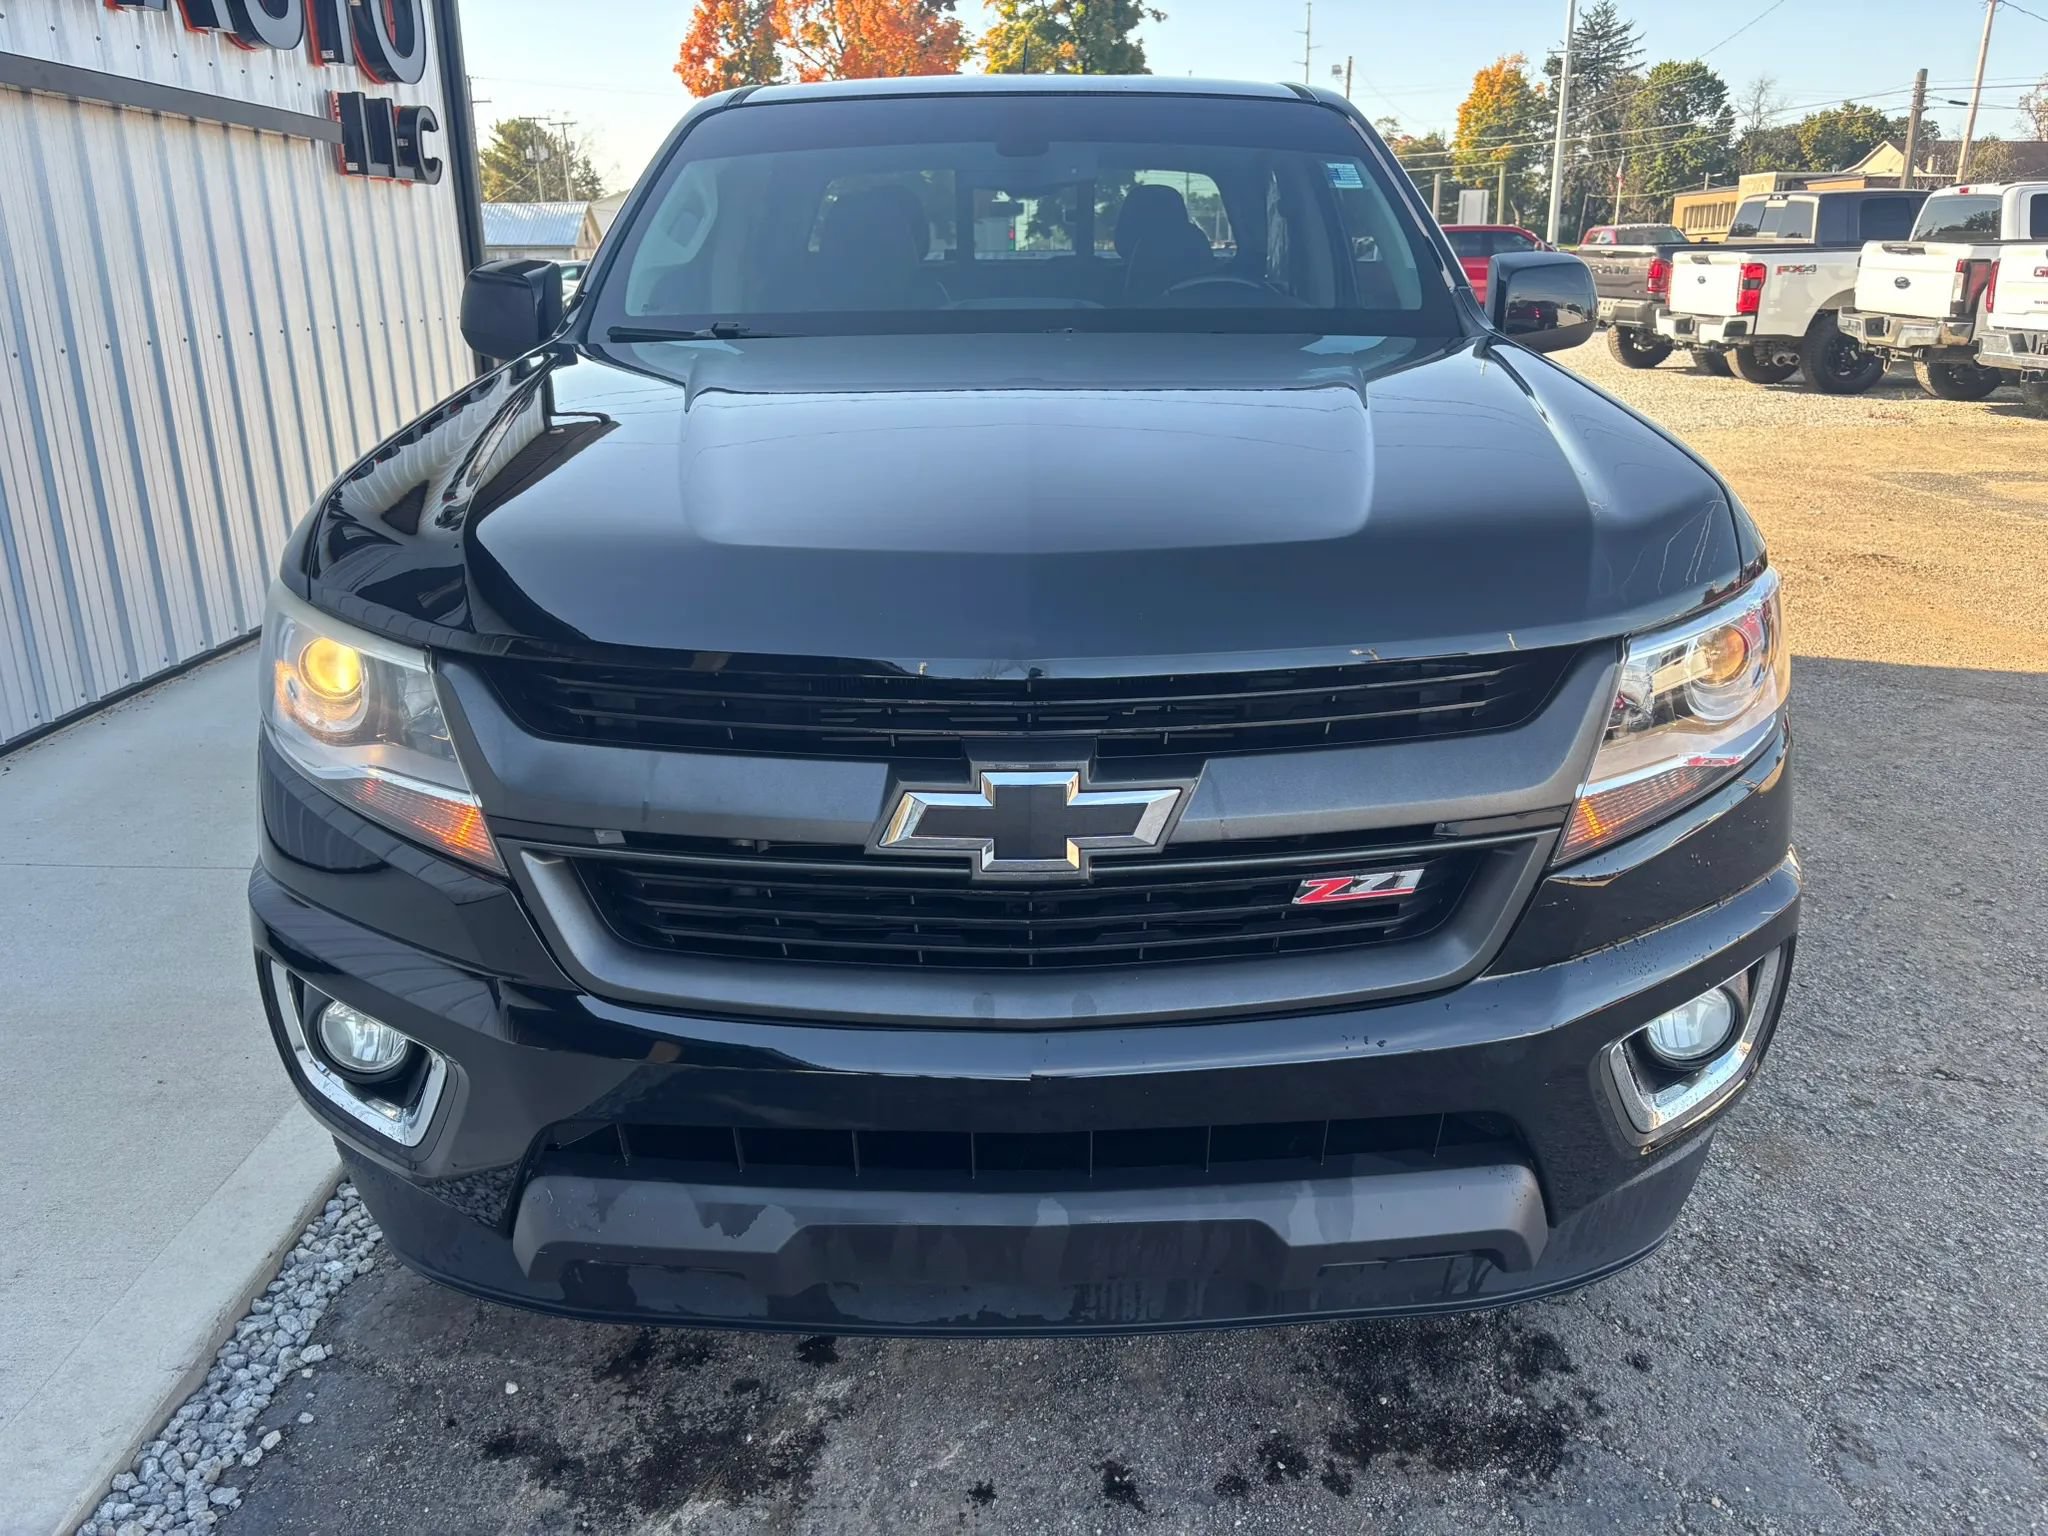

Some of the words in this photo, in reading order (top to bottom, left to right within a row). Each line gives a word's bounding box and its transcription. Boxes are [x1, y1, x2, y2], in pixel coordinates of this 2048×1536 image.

[335, 91, 443, 184] LLC
[1589, 264, 1630, 275] RAM
[1775, 264, 1817, 275] FX4
[1292, 868, 1425, 904] Z71
